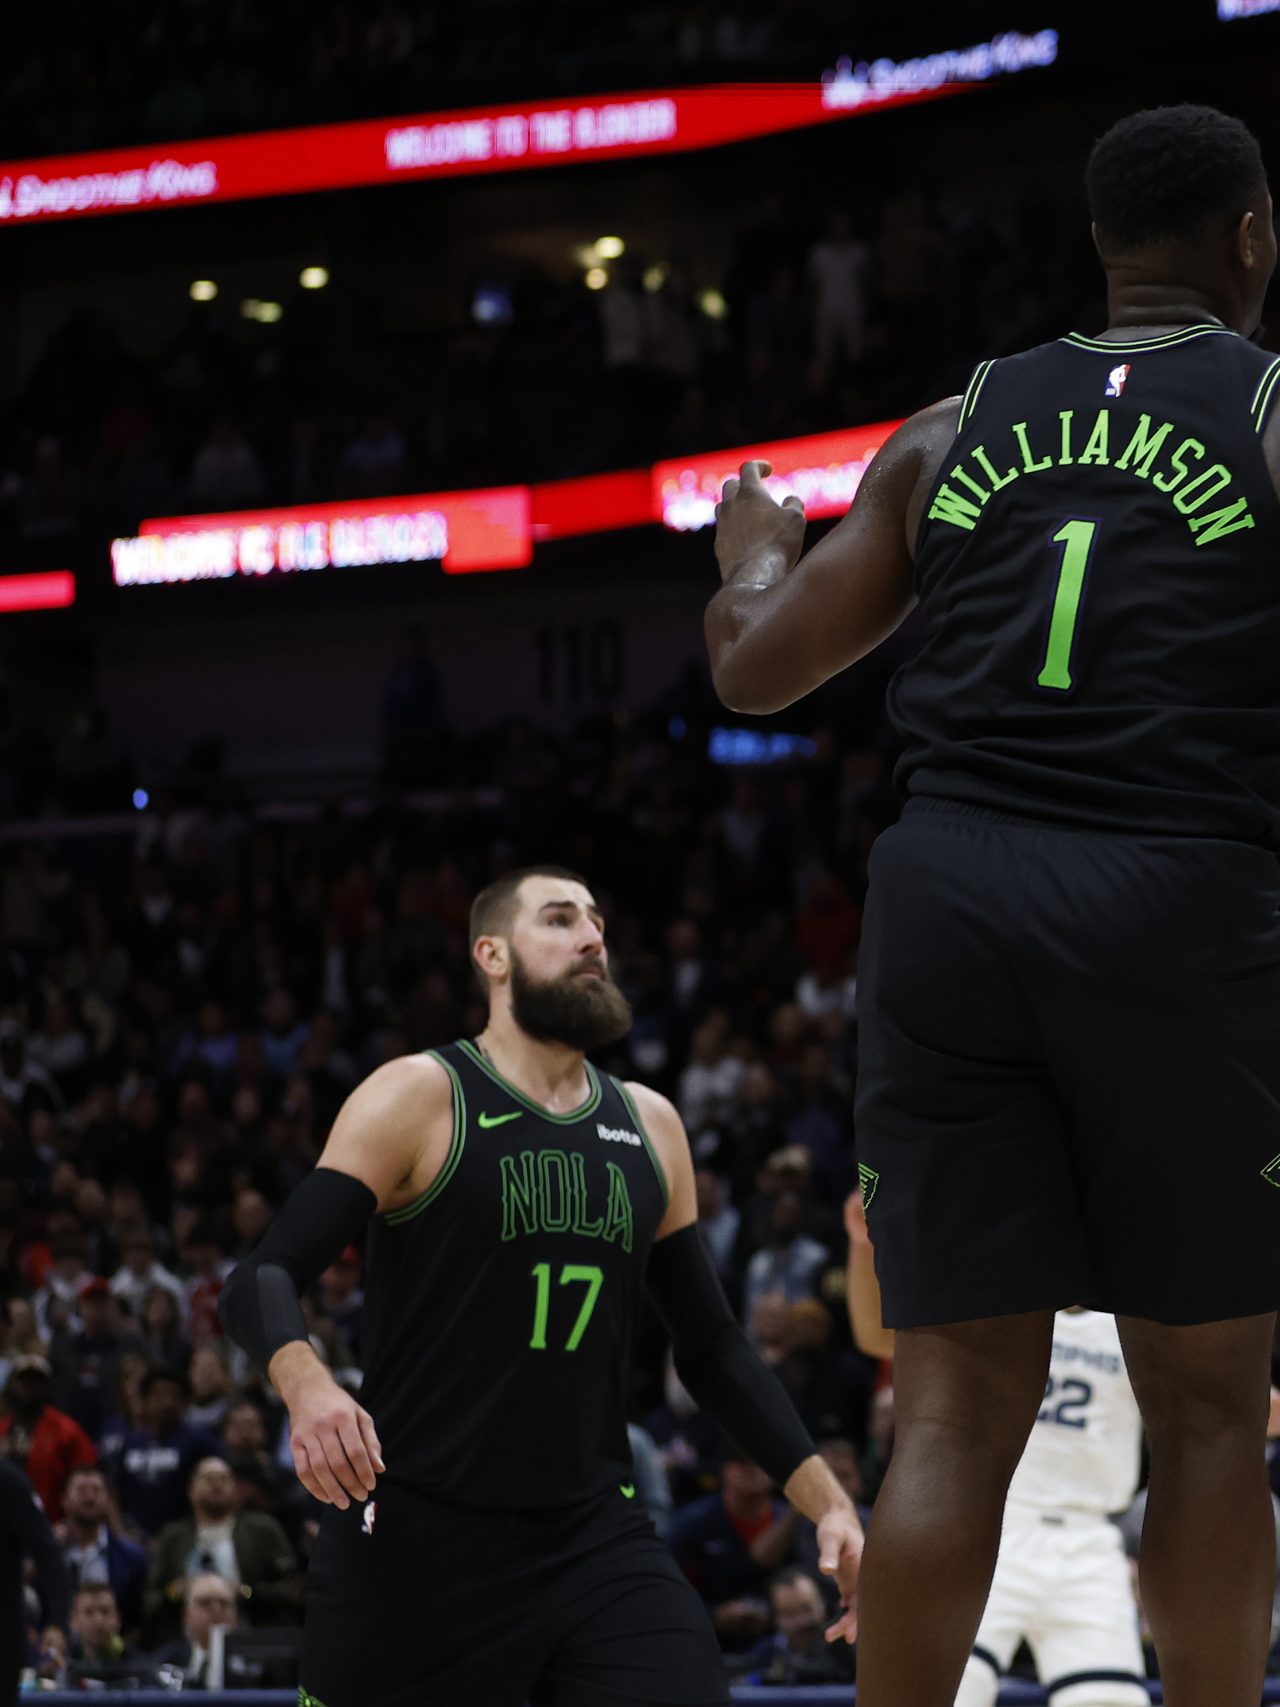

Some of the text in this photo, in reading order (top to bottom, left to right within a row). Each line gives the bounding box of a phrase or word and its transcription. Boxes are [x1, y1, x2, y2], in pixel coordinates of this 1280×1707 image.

[385, 118, 494, 170] WELCOME
[495, 115, 528, 158] TO
[529, 109, 573, 154] THE
[16, 158, 218, 218] SMOOTHIE KING
[927, 409, 1255, 546] WILLIAMSON
[1037, 519, 1097, 690] 1
[596, 1123, 642, 1147] ibotta
[500, 1149, 633, 1254] NOLA
[529, 1262, 604, 1352] 17
